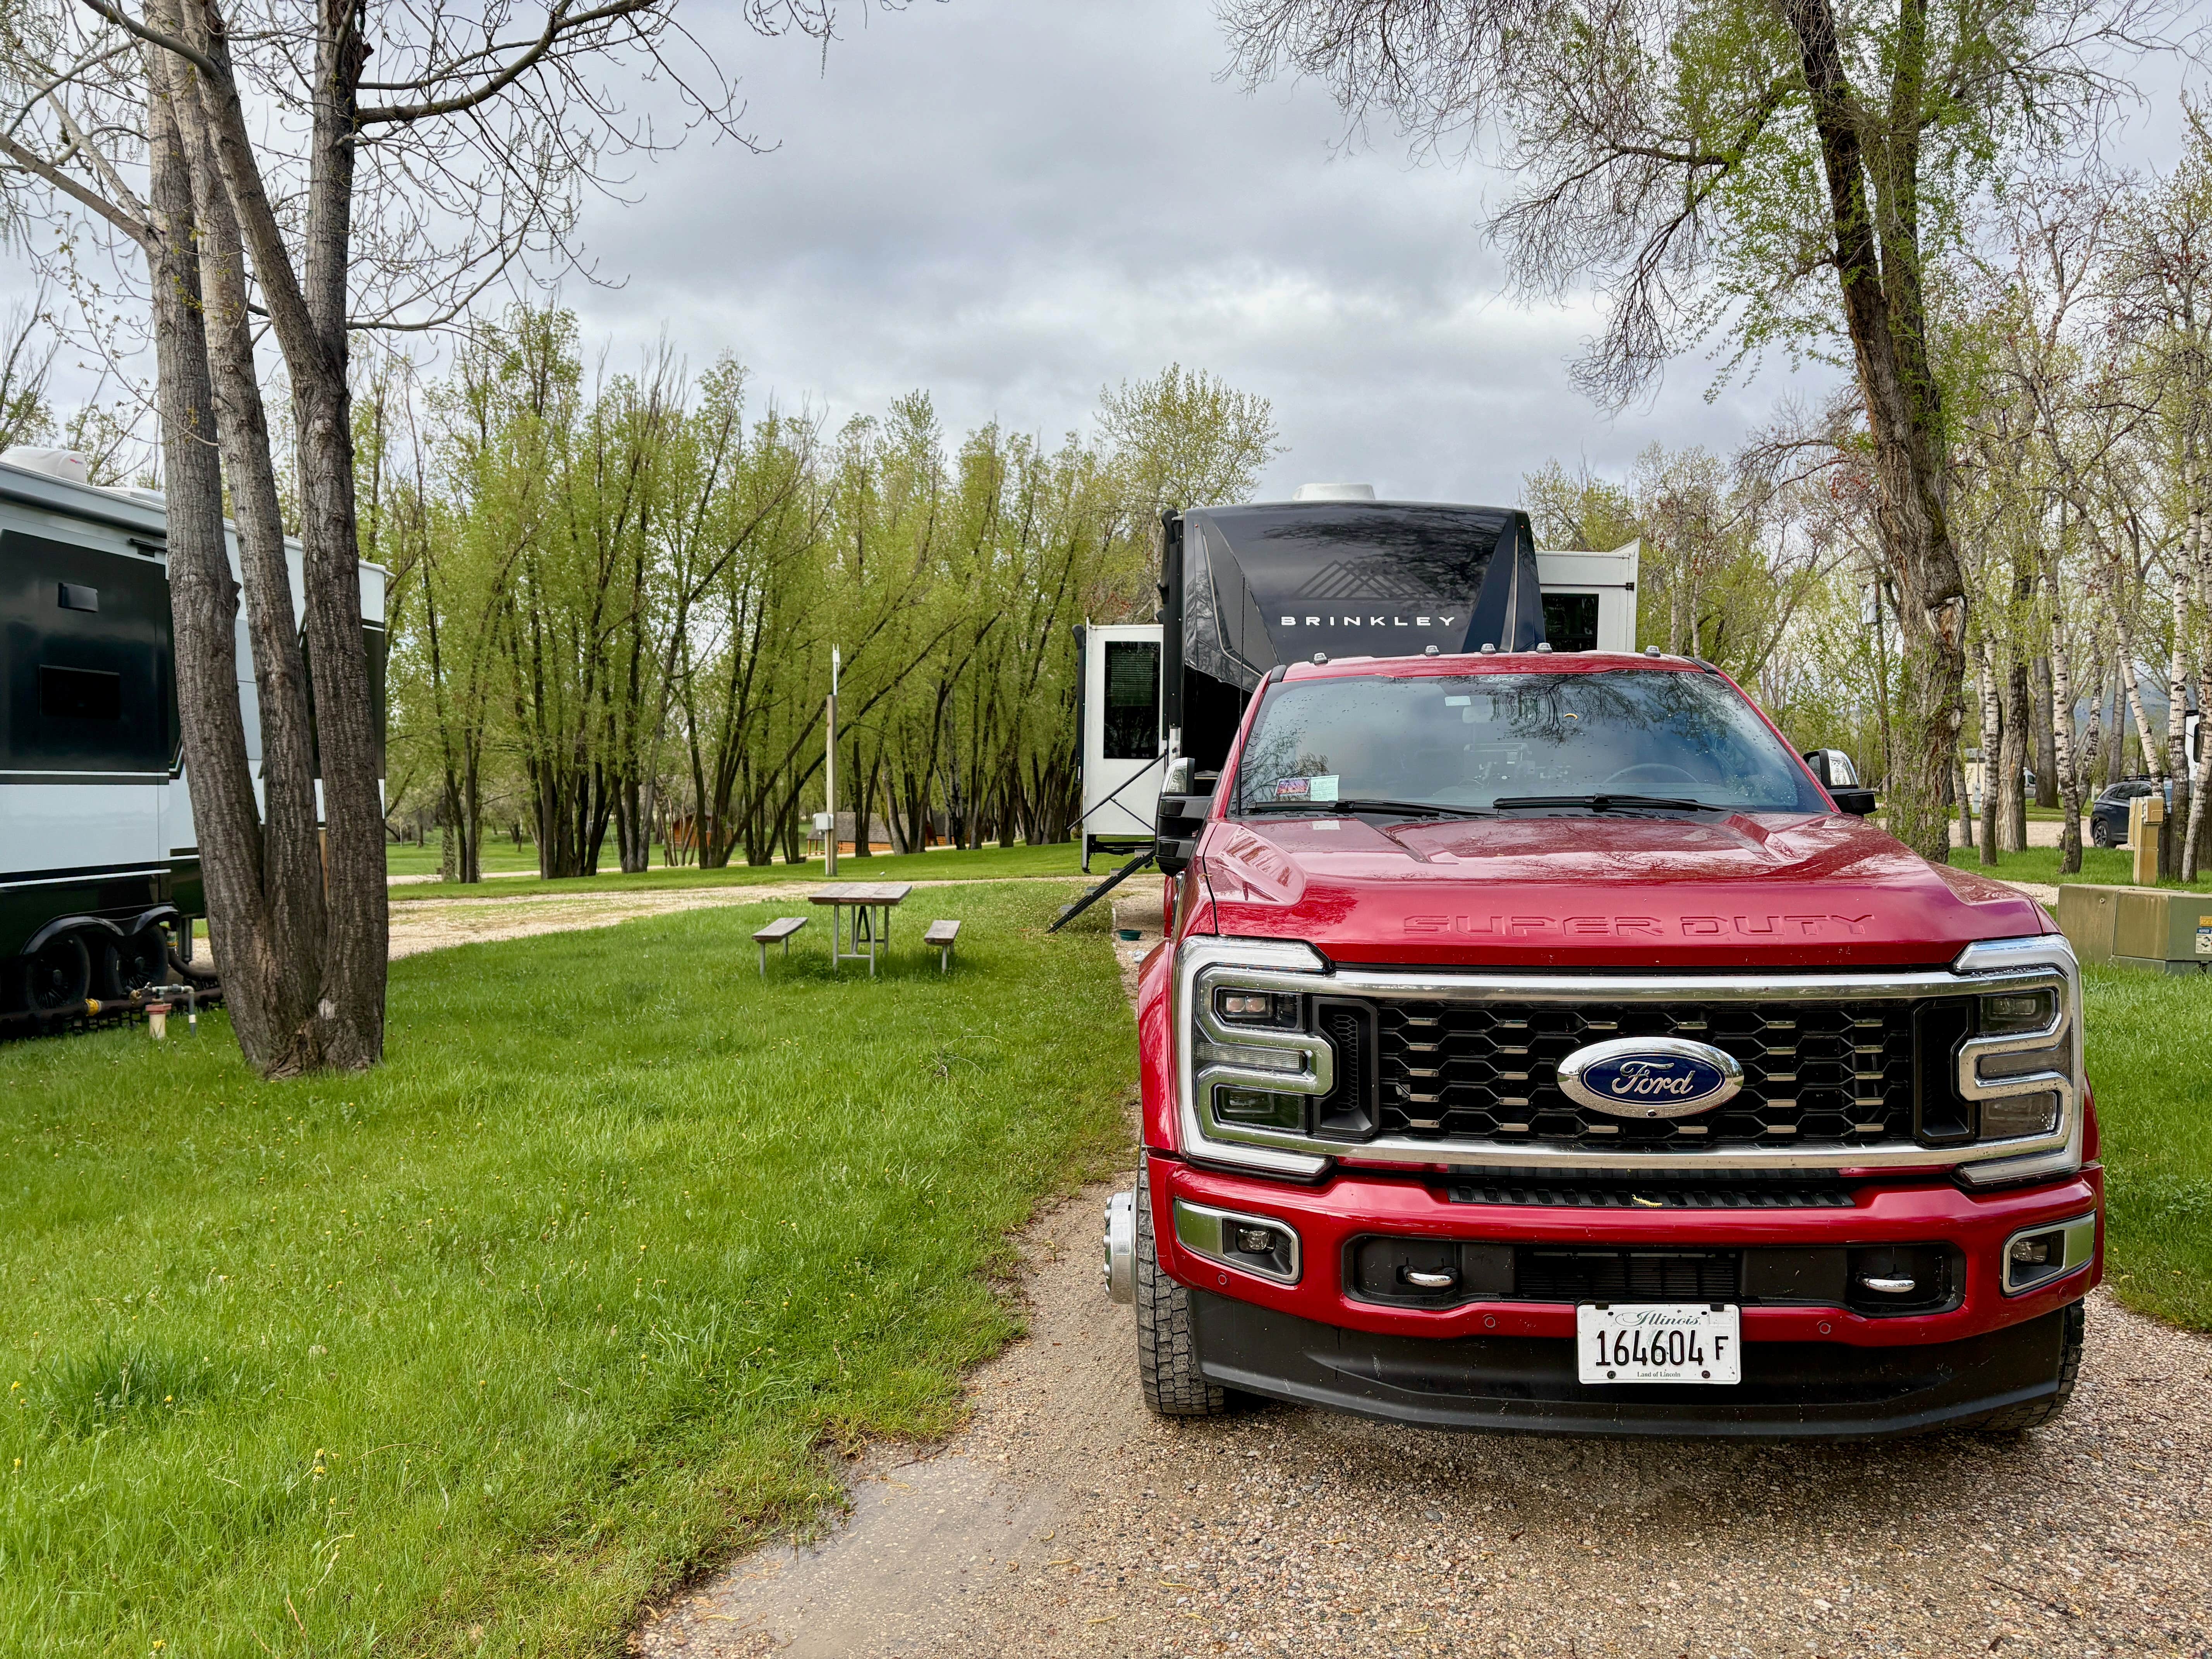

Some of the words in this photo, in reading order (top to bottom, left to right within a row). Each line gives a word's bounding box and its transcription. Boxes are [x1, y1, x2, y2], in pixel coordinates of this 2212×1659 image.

[1281, 616, 1455, 626] BRINKLEY
[1404, 915, 1664, 937] SUPER
[1681, 914, 1875, 936] DUTY
[1612, 1061, 1696, 1094] Ford
[1615, 1310, 1700, 1326] Illinois
[1595, 1329, 1704, 1366] 164604
[1715, 1336, 1728, 1360] F
